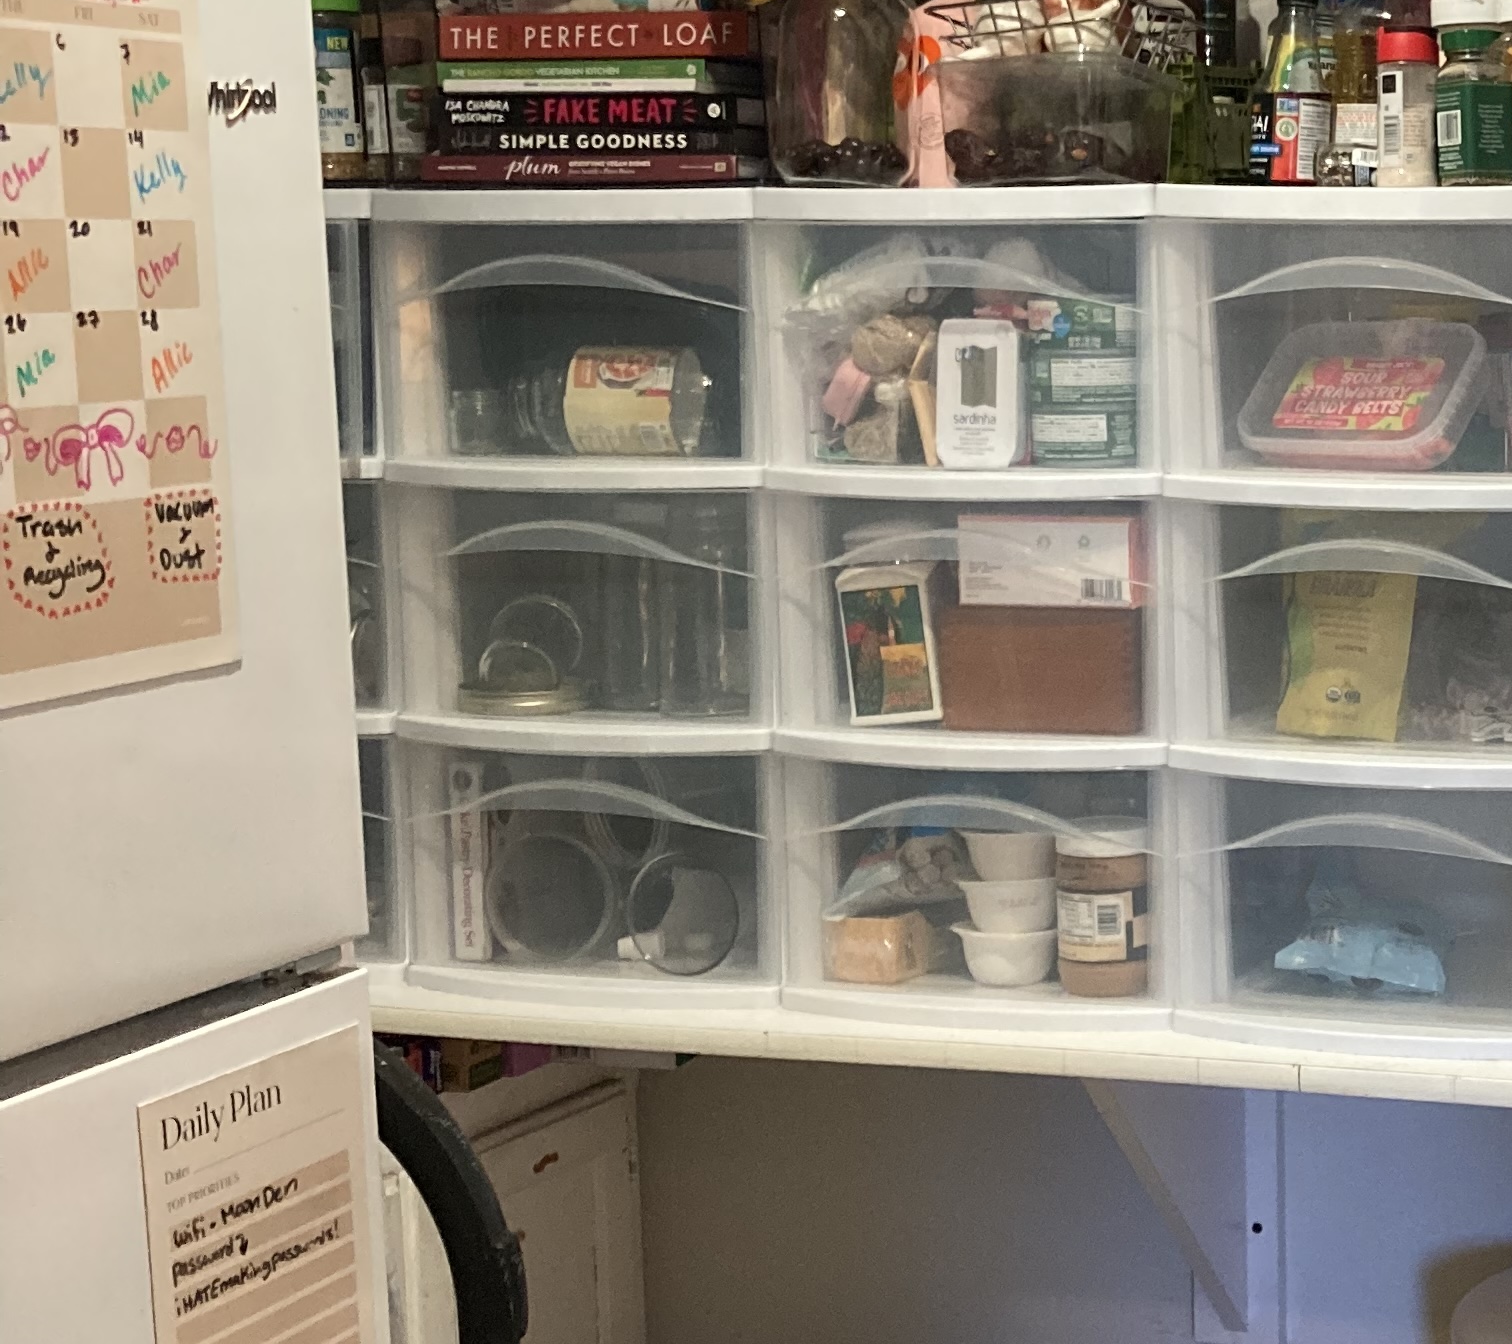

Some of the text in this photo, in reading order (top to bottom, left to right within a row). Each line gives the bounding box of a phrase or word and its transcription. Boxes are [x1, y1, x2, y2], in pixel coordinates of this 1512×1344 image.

[75, 6, 93, 20] FRI
[138, 12, 160, 27] SAT
[56, 32, 66, 51] 6
[327, 37, 348, 51] NEW
[450, 22, 733, 49] THE PERFECT LOAF
[451, 68, 465, 78] THE
[535, 66, 584, 77] VEGETARIAN
[585, 66, 620, 76] KITCHEN
[0, 61, 53, 104] elly
[131, 71, 171, 117] Mia
[445, 99, 510, 114] ISA CHANDRA
[543, 98, 678, 125] FAKE MEAT
[451, 112, 505, 125] MOSKOWITZ
[128, 129, 144, 148] 14
[499, 133, 688, 150] SIMPLE GOODNESS
[2, 147, 50, 202] Char
[134, 151, 187, 204] Kelly
[505, 156, 561, 180] plum
[3, 221, 20, 238] 19
[69, 220, 90, 238] 20
[137, 221, 153, 237] 21
[137, 243, 182, 299] Char
[5, 313, 26, 334] 26
[76, 310, 100, 329] 27
[140, 309, 159, 332] 28
[16, 347, 56, 397] Mia
[1340, 371, 1387, 384] SOUR
[1300, 385, 1412, 399] STRAWBERRY
[1294, 399, 1402, 415] CANDY BELTS
[953, 412, 997, 425] sardinha
[16, 514, 83, 538] Trash
[160, 543, 206, 570] Dust
[24, 556, 106, 599] Recycling
[160, 1083, 282, 1151] Daily Plan
[187, 1172, 240, 1206] PRIORITIES
